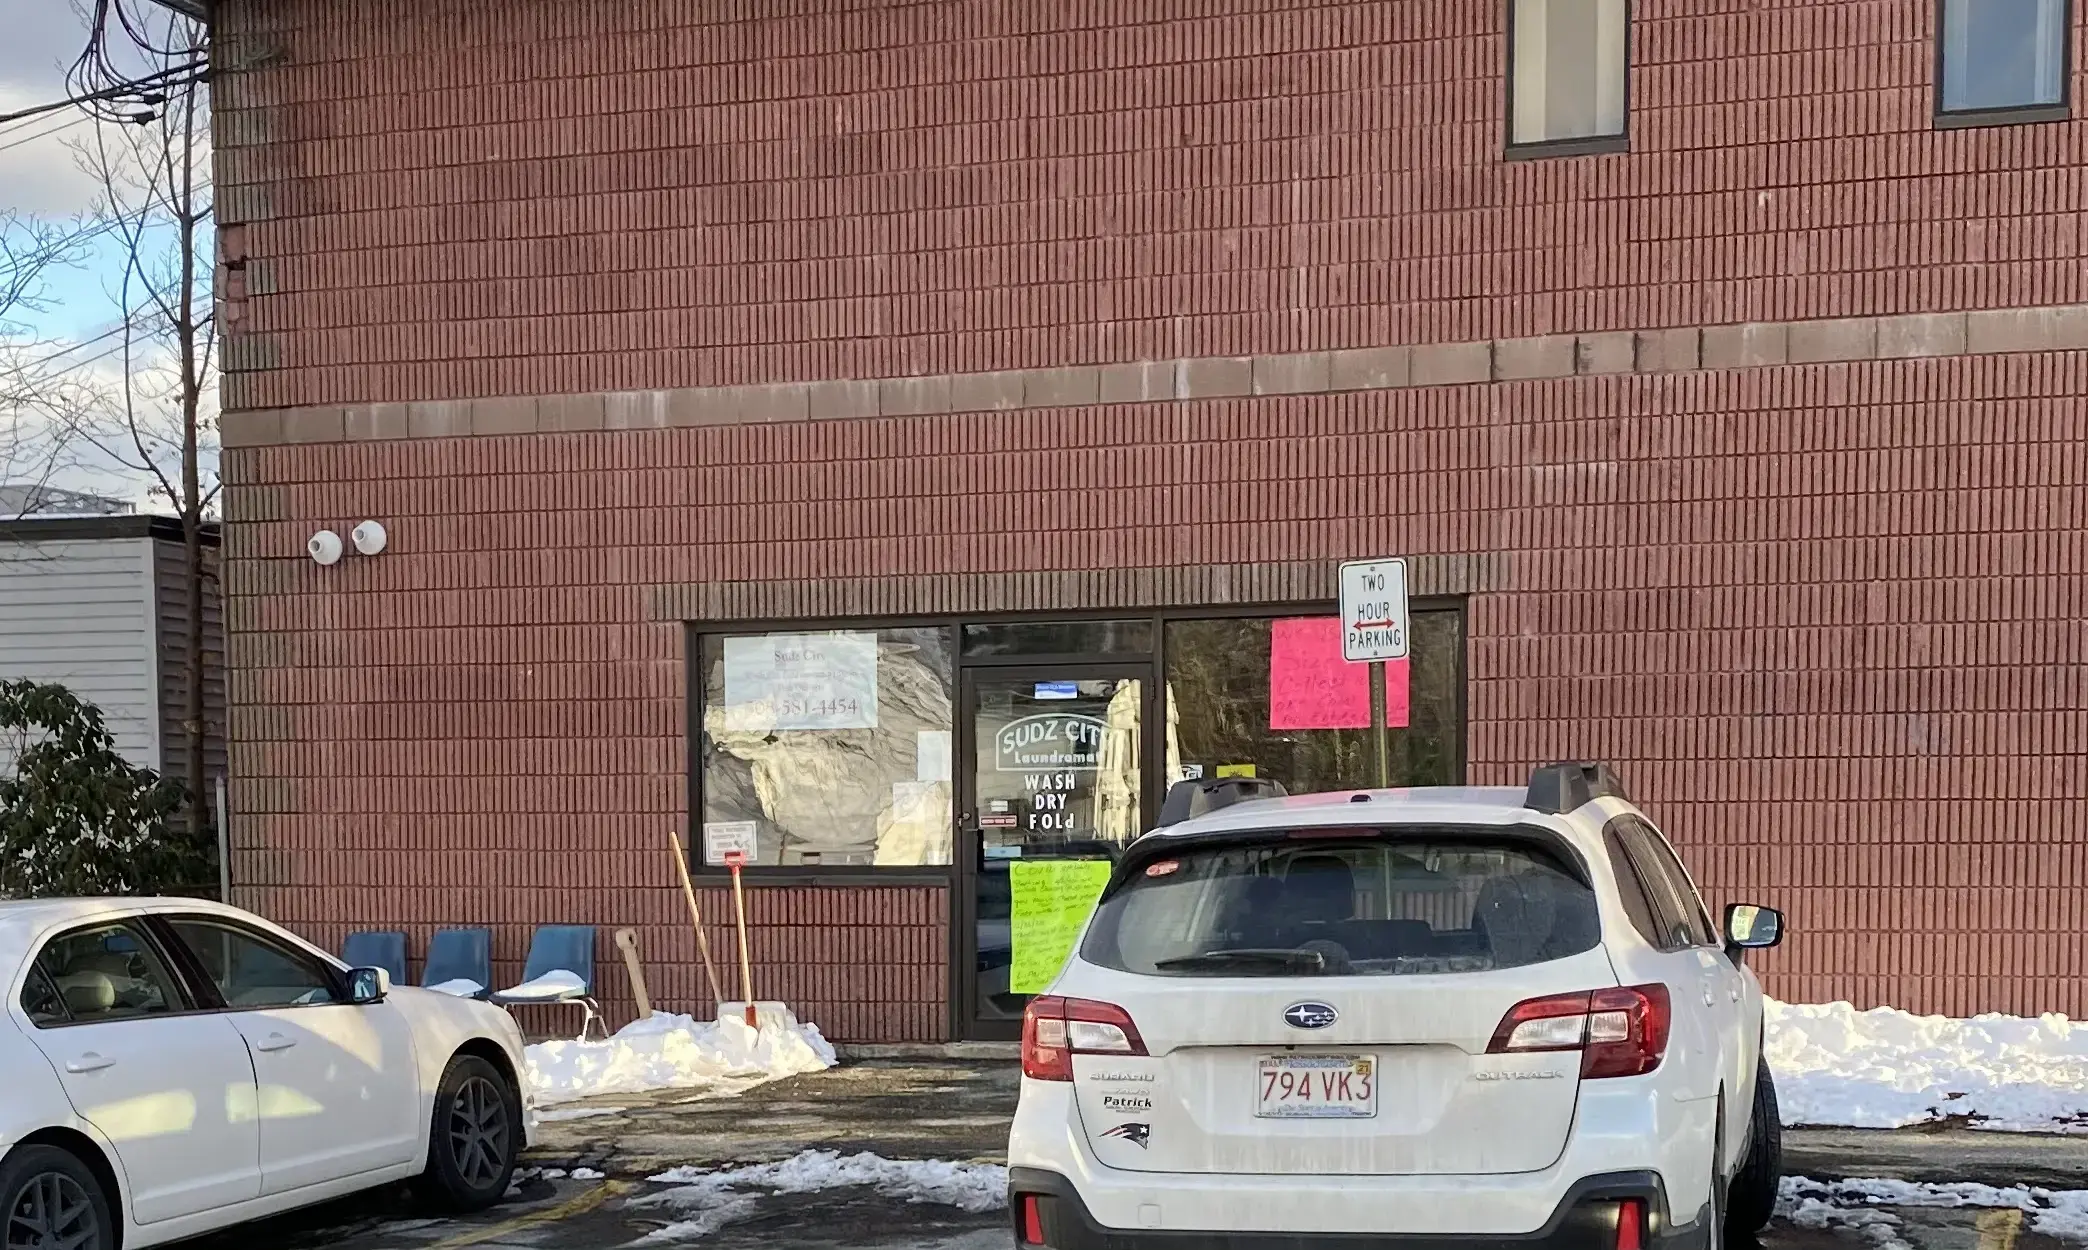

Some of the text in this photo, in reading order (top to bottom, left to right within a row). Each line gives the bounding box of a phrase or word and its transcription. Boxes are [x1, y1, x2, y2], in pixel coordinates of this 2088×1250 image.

[1361, 574, 1385, 592] TWO
[1358, 601, 1390, 621] HOUR
[1349, 628, 1401, 650] PARKING
[1002, 720, 1102, 754] SUDZ CIT
[1024, 773, 1076, 790] WASH
[1035, 794, 1067, 810] DRY
[1090, 1072, 1155, 1082] SUBARU
[1358, 1064, 1369, 1073] 21
[1475, 1070, 1565, 1081] OUTBACK
[1263, 1071, 1372, 1102] 794 VK3
[1103, 1096, 1152, 1108] Patrick
